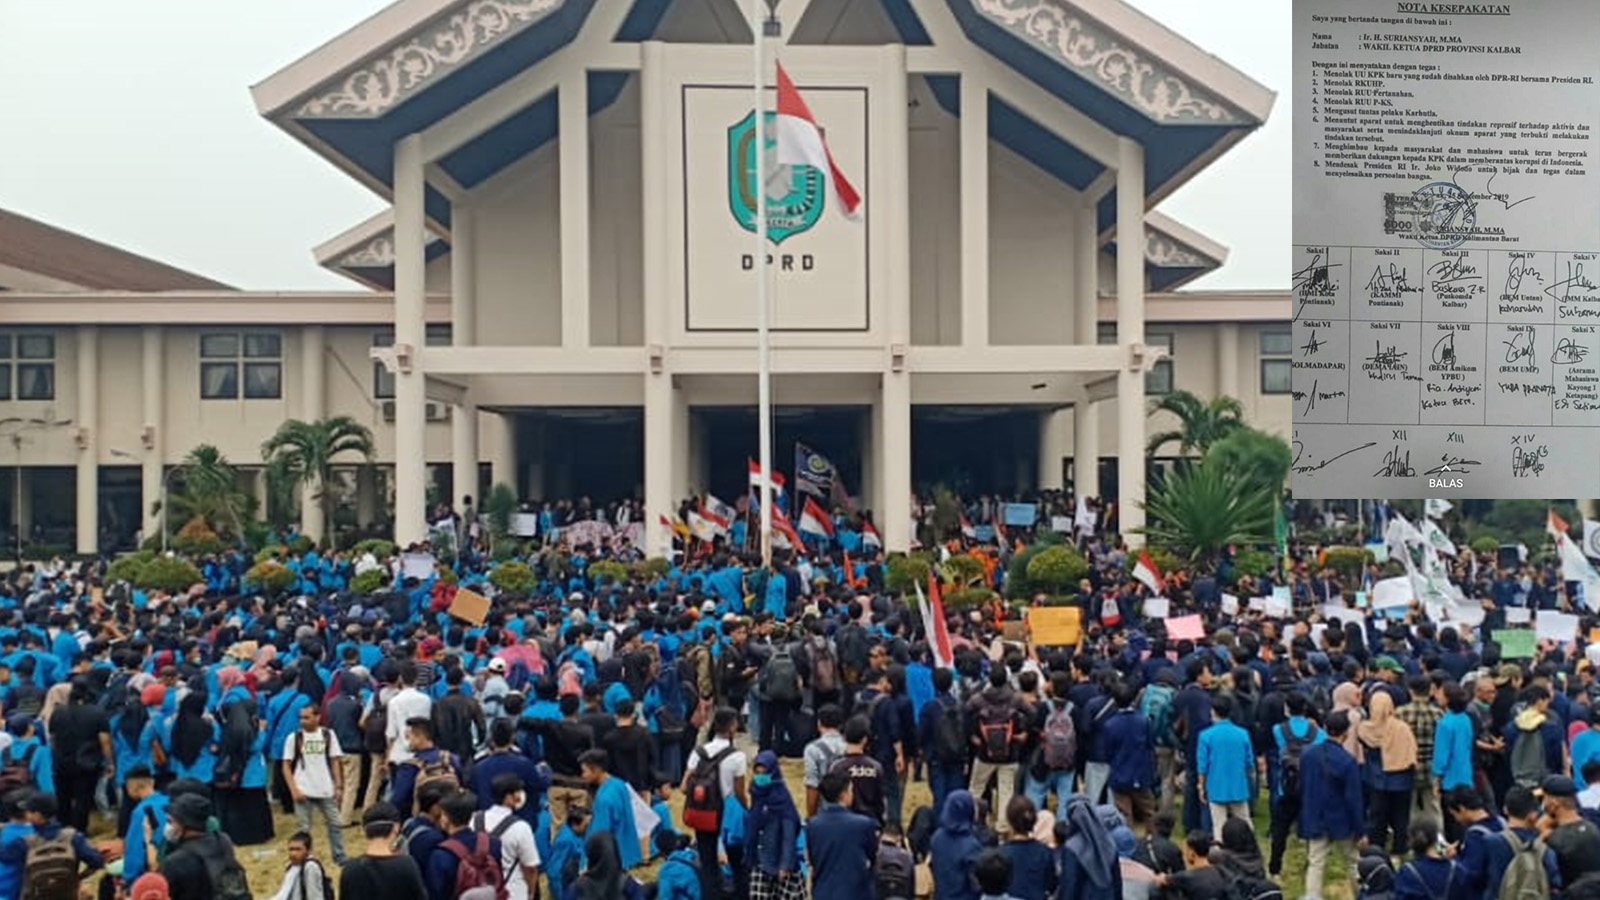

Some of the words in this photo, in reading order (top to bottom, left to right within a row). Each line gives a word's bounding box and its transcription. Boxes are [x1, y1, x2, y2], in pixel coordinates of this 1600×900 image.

[1397, 2, 1428, 12] NOTA
[1430, 4, 1510, 16] KESEPAKATAN
[1312, 15, 1329, 23] Saya
[1383, 35, 1438, 43] SURIANSYAH,
[1312, 61, 1338, 70] Dengan
[1349, 62, 1391, 71] menyatakan
[1392, 63, 1417, 72] dengan
[1373, 89, 1414, 97] Pertanahan.
[1324, 107, 1357, 116] Mengusut
[1381, 109, 1404, 118] pelaku
[1407, 119, 1455, 128] menghentikan
[1490, 121, 1517, 130] represif
[1519, 122, 1550, 131] terhadap
[1324, 126, 1364, 134] masyarakat
[1387, 127, 1443, 137] menindaklanjuti
[1324, 143, 1369, 152] Menghimbau
[1373, 145, 1399, 153] kepada
[1403, 145, 1443, 154] masyarakat
[1557, 150, 1588, 159] bergerak
[1367, 152, 1401, 162] dukungan
[1402, 153, 1427, 163] kepada
[1468, 157, 1514, 166] memberantas
[1514, 158, 1541, 166] korupsi
[1550, 157, 1583, 166] Indonesia.
[1411, 162, 1420, 170] Ir.
[1502, 167, 1520, 175] bijak
[1325, 170, 1373, 179] menyelesaikan
[1374, 172, 1406, 180] persoalan
[1392, 430, 1407, 441] XII
[1446, 432, 1464, 444] XIII
